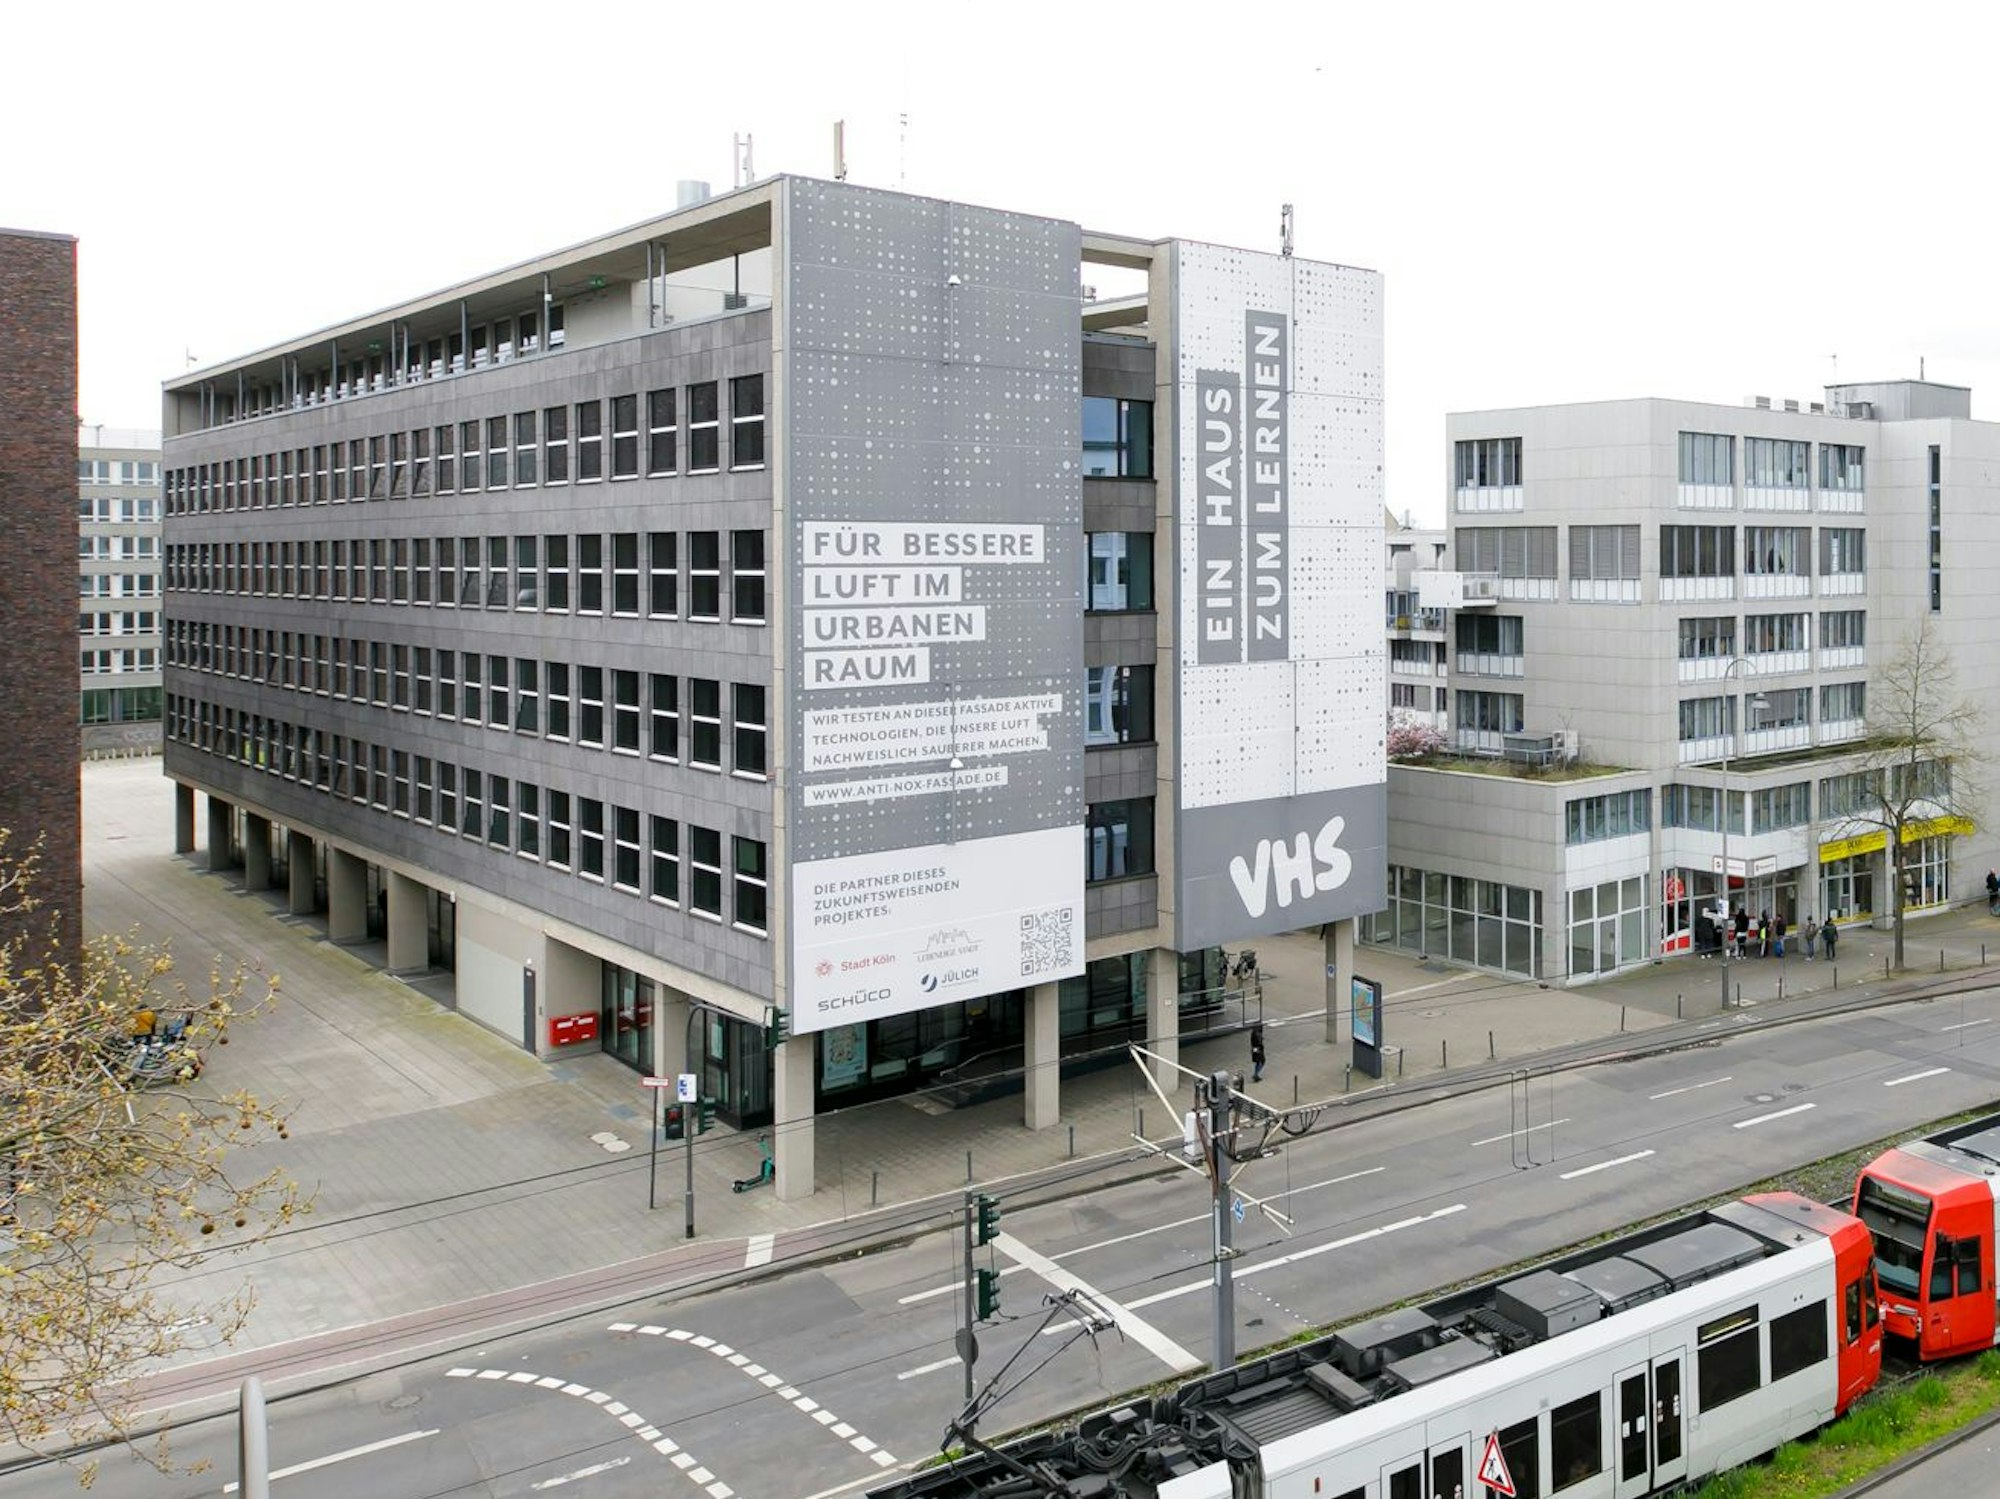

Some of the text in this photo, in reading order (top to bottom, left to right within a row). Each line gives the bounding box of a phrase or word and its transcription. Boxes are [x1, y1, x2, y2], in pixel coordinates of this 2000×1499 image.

[1254, 325, 1283, 640] ZUM LERNEN
[1204, 387, 1234, 641] EIN HAUS
[814, 525, 1034, 556] FÜR BESSERE
[814, 573, 950, 599] LUFT IM
[814, 612, 974, 641] URBANEN
[814, 654, 916, 683] RAUM
[812, 713, 840, 726] WIR
[842, 710, 891, 723] TESTEN
[893, 708, 911, 720] AN
[959, 701, 1012, 714] FASSADE
[1013, 698, 1054, 711] AKTIVE
[926, 725, 946, 736] DIE
[950, 721, 998, 733] UNSERE
[1001, 718, 1031, 730] LUFT
[813, 746, 917, 766] NACHWEISLICH
[922, 741, 985, 756] SAUBERER
[1229, 815, 1352, 918] VHS
[814, 867, 947, 895] DIE PARTNER DIESES
[814, 880, 960, 911] ZUKUNFTSWEISENDEN
[840, 953, 896, 972] Stadt Köln
[941, 967, 979, 984] JÜLICH
[817, 988, 891, 1013] SCHÜCO
